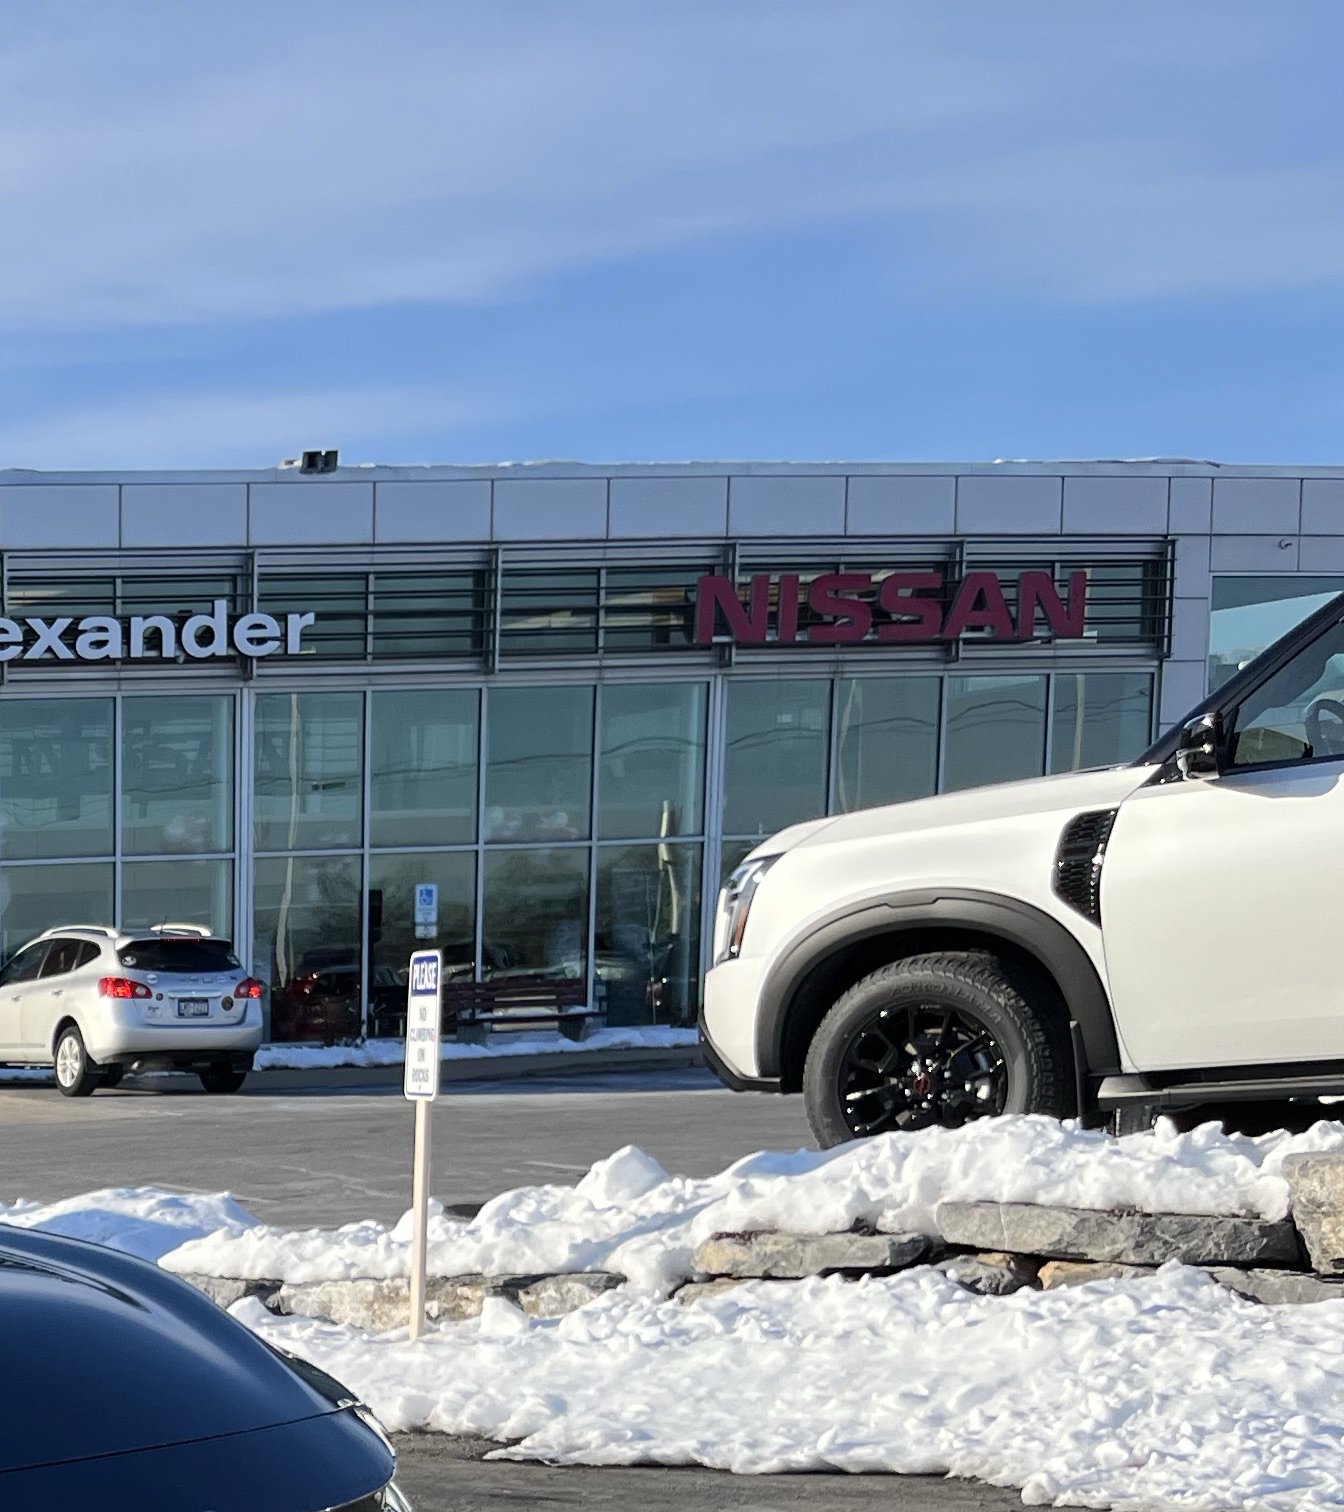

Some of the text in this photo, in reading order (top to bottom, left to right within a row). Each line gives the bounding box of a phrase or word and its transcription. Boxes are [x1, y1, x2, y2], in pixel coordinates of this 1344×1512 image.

[694, 571, 1087, 644] NISSAN
[412, 961, 437, 991] PLEASE
[418, 1007, 428, 1022] NO
